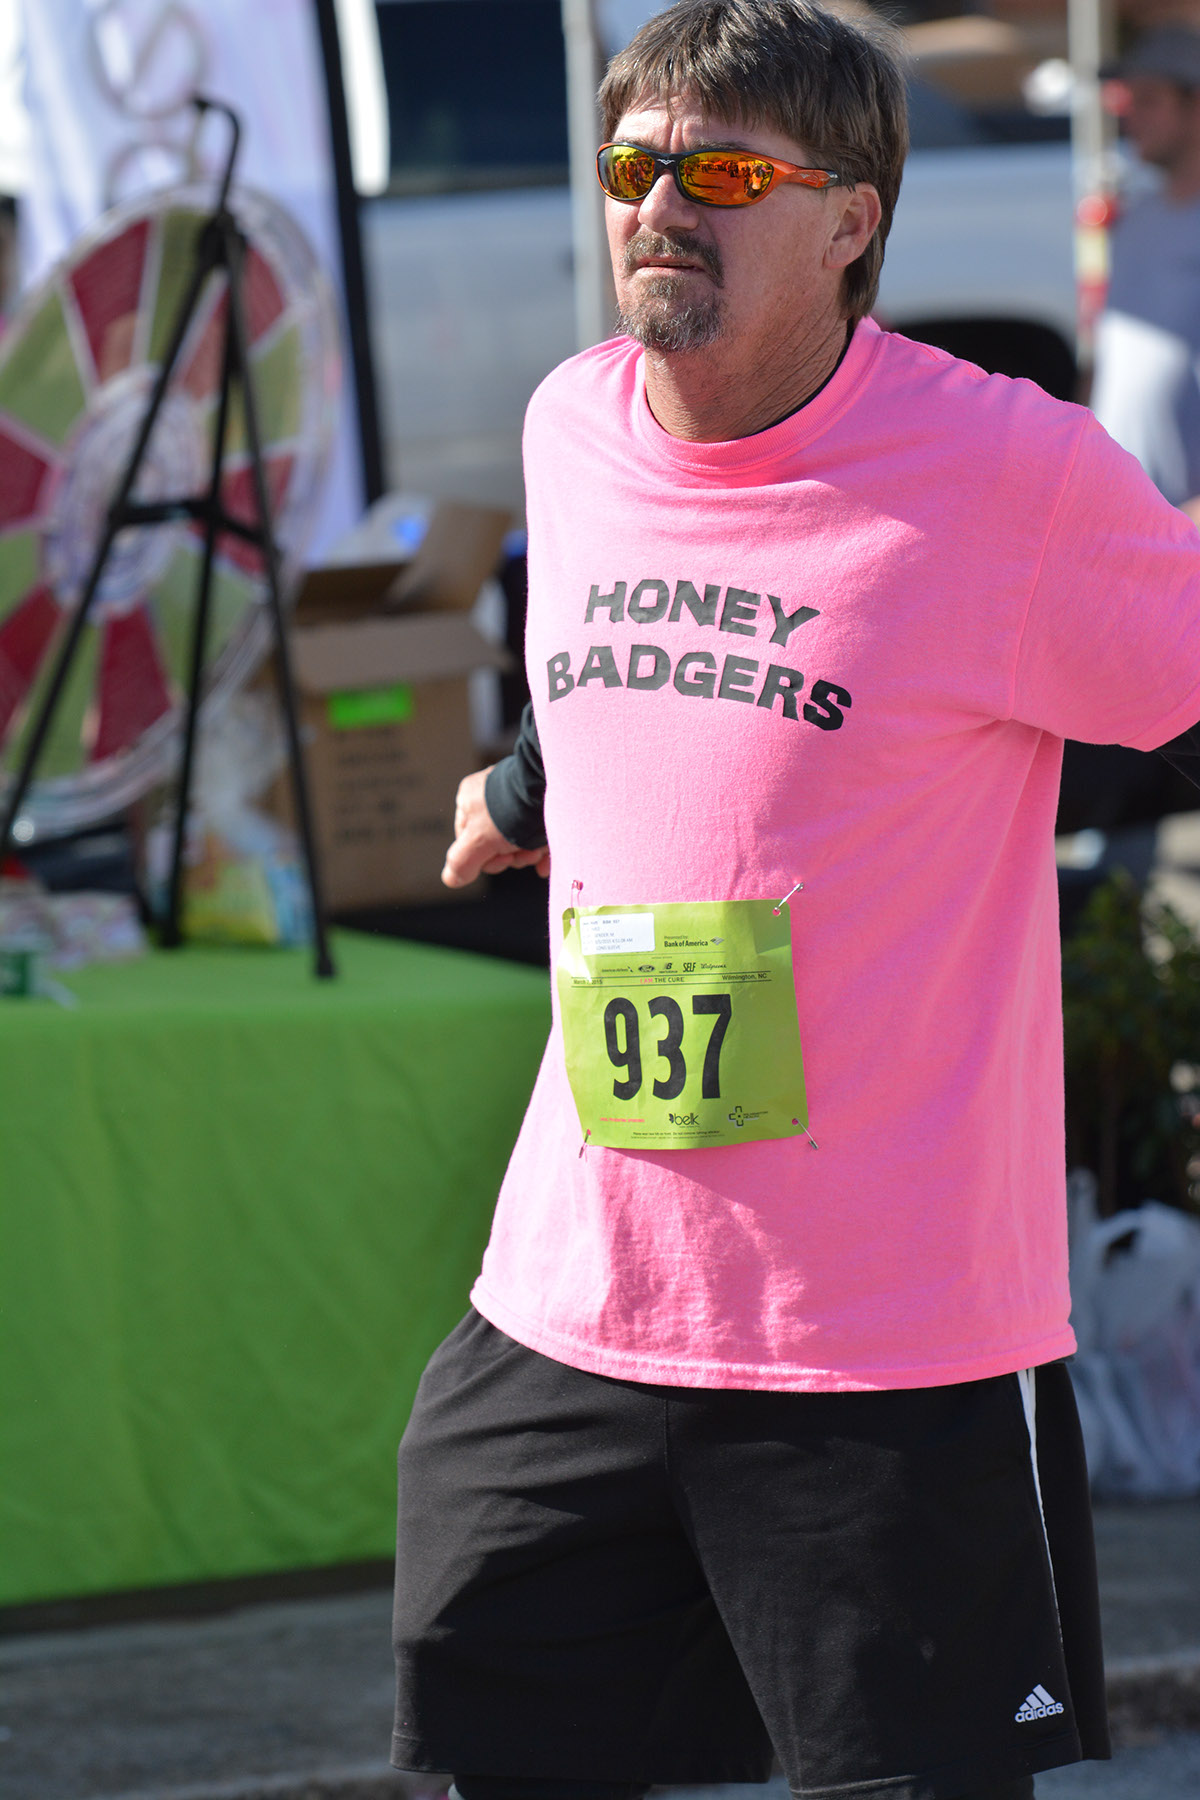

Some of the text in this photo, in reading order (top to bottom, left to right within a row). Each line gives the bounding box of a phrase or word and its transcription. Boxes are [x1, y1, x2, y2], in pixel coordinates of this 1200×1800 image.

[584, 579, 821, 648] HONEY
[546, 644, 852, 731] BADGERS
[683, 962, 696, 972] SELF
[604, 993, 732, 1101] 937
[674, 1113, 700, 1126] belk
[1014, 1702, 1064, 1723] adidas
